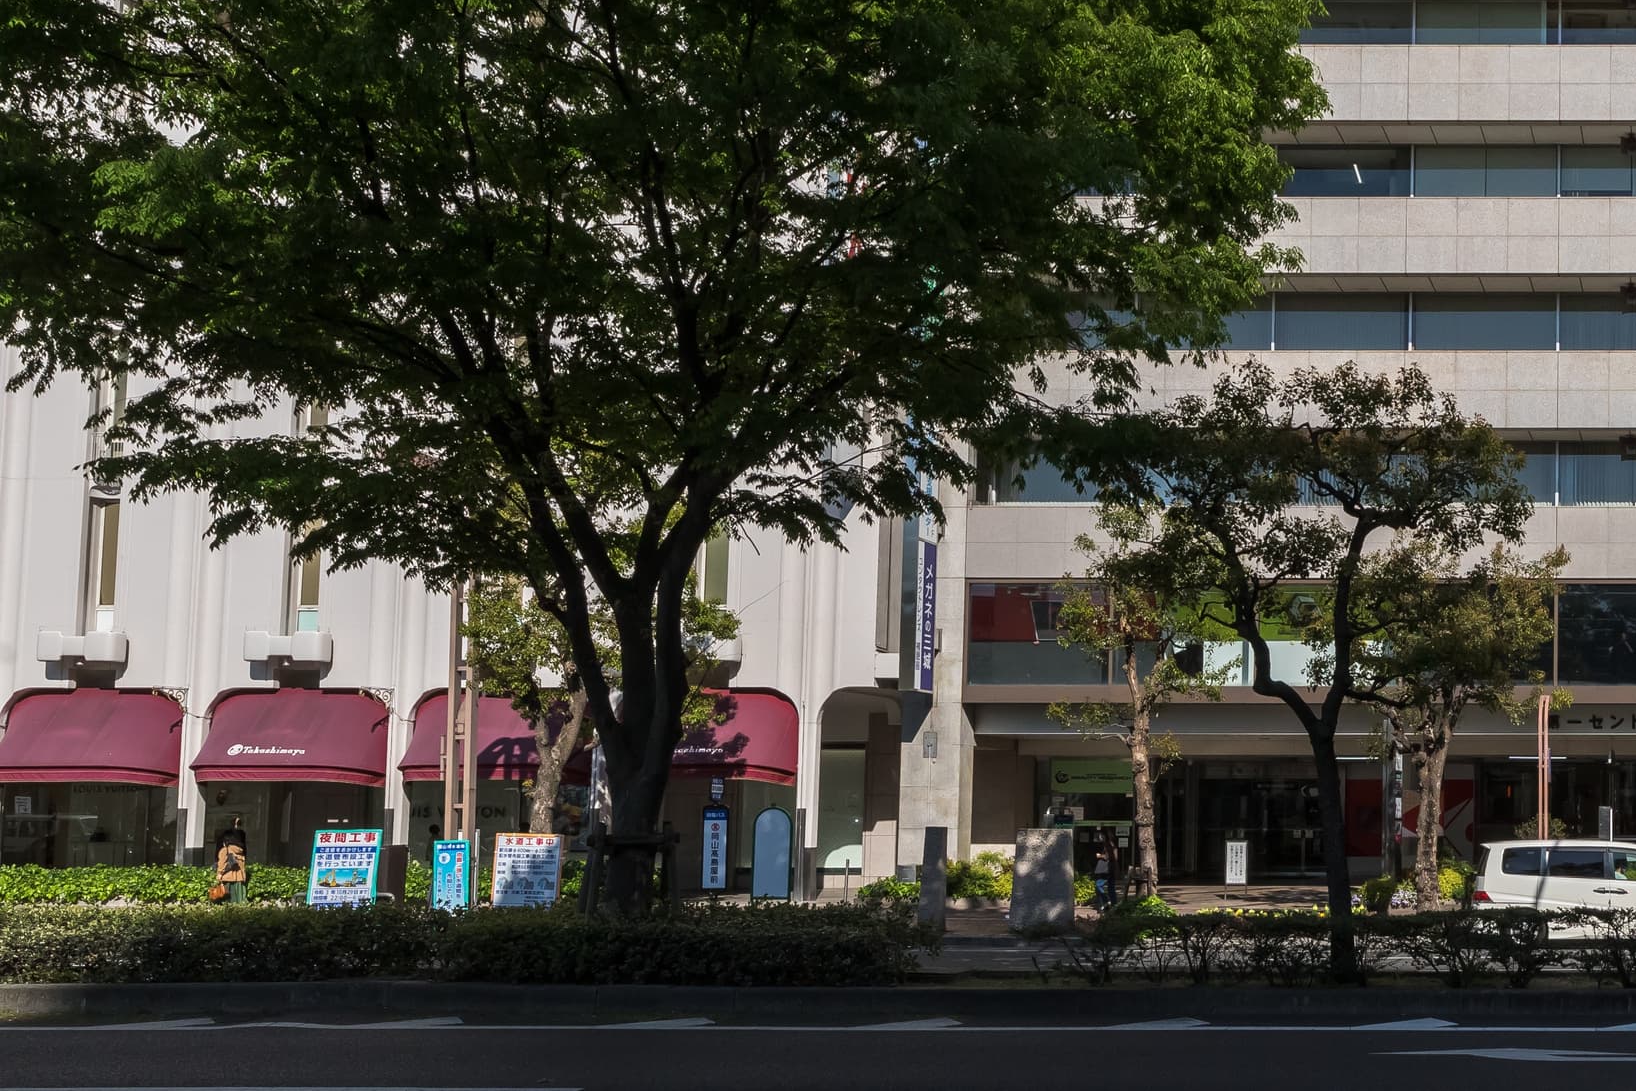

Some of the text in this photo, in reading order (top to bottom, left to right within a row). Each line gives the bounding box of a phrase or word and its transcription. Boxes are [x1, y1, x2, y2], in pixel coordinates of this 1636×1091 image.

[923, 563, 934, 671] メガネの三城
[243, 745, 306, 757] Takashimaya
[320, 833, 377, 843] 夜間工事
[505, 837, 554, 846] 水道工事中
